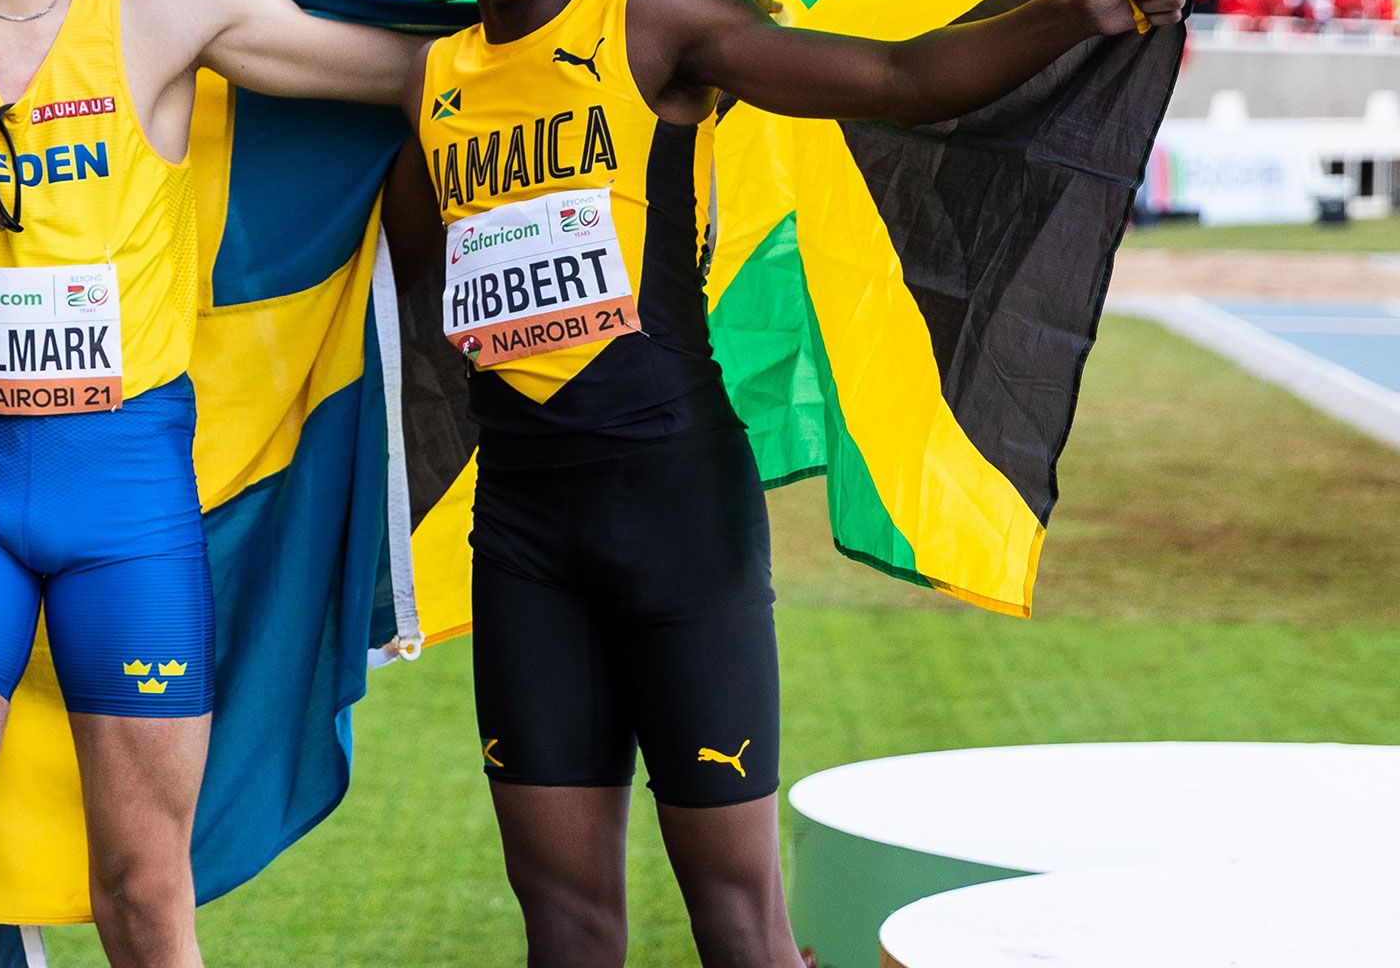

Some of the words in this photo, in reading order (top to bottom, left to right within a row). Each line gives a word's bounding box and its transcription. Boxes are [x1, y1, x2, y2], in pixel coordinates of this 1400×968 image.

[31, 98, 115, 123] BAUHAUS
[561, 196, 594, 208] BEYOND
[461, 222, 540, 255] Safaricom
[71, 274, 103, 283] BEYOND
[452, 248, 608, 328] HIBBERT
[491, 315, 589, 354] NAIROBI
[595, 307, 626, 331] 21
[83, 386, 111, 405] 21
